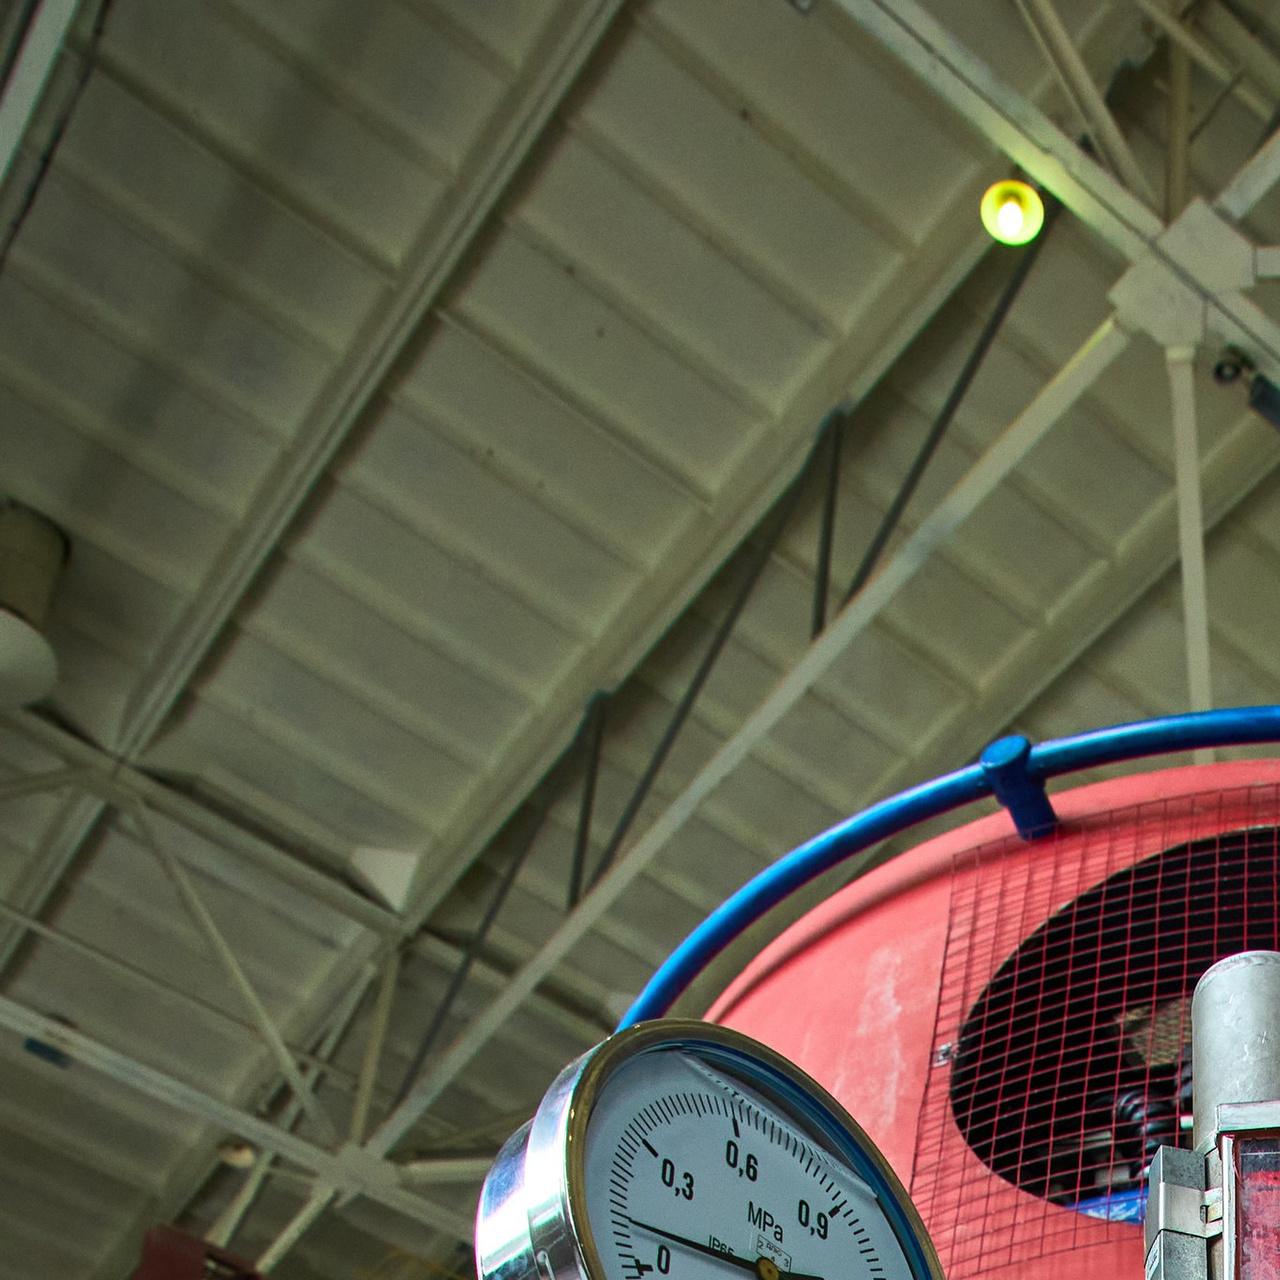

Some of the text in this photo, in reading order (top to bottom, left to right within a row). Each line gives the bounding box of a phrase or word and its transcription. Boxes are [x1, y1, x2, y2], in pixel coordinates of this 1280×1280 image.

[661, 1158, 694, 1200] 0,3
[726, 1140, 758, 1182] 0,6
[748, 1200, 784, 1243] MPa
[798, 1199, 828, 1240] 0,9
[657, 1244, 671, 1274] 0
